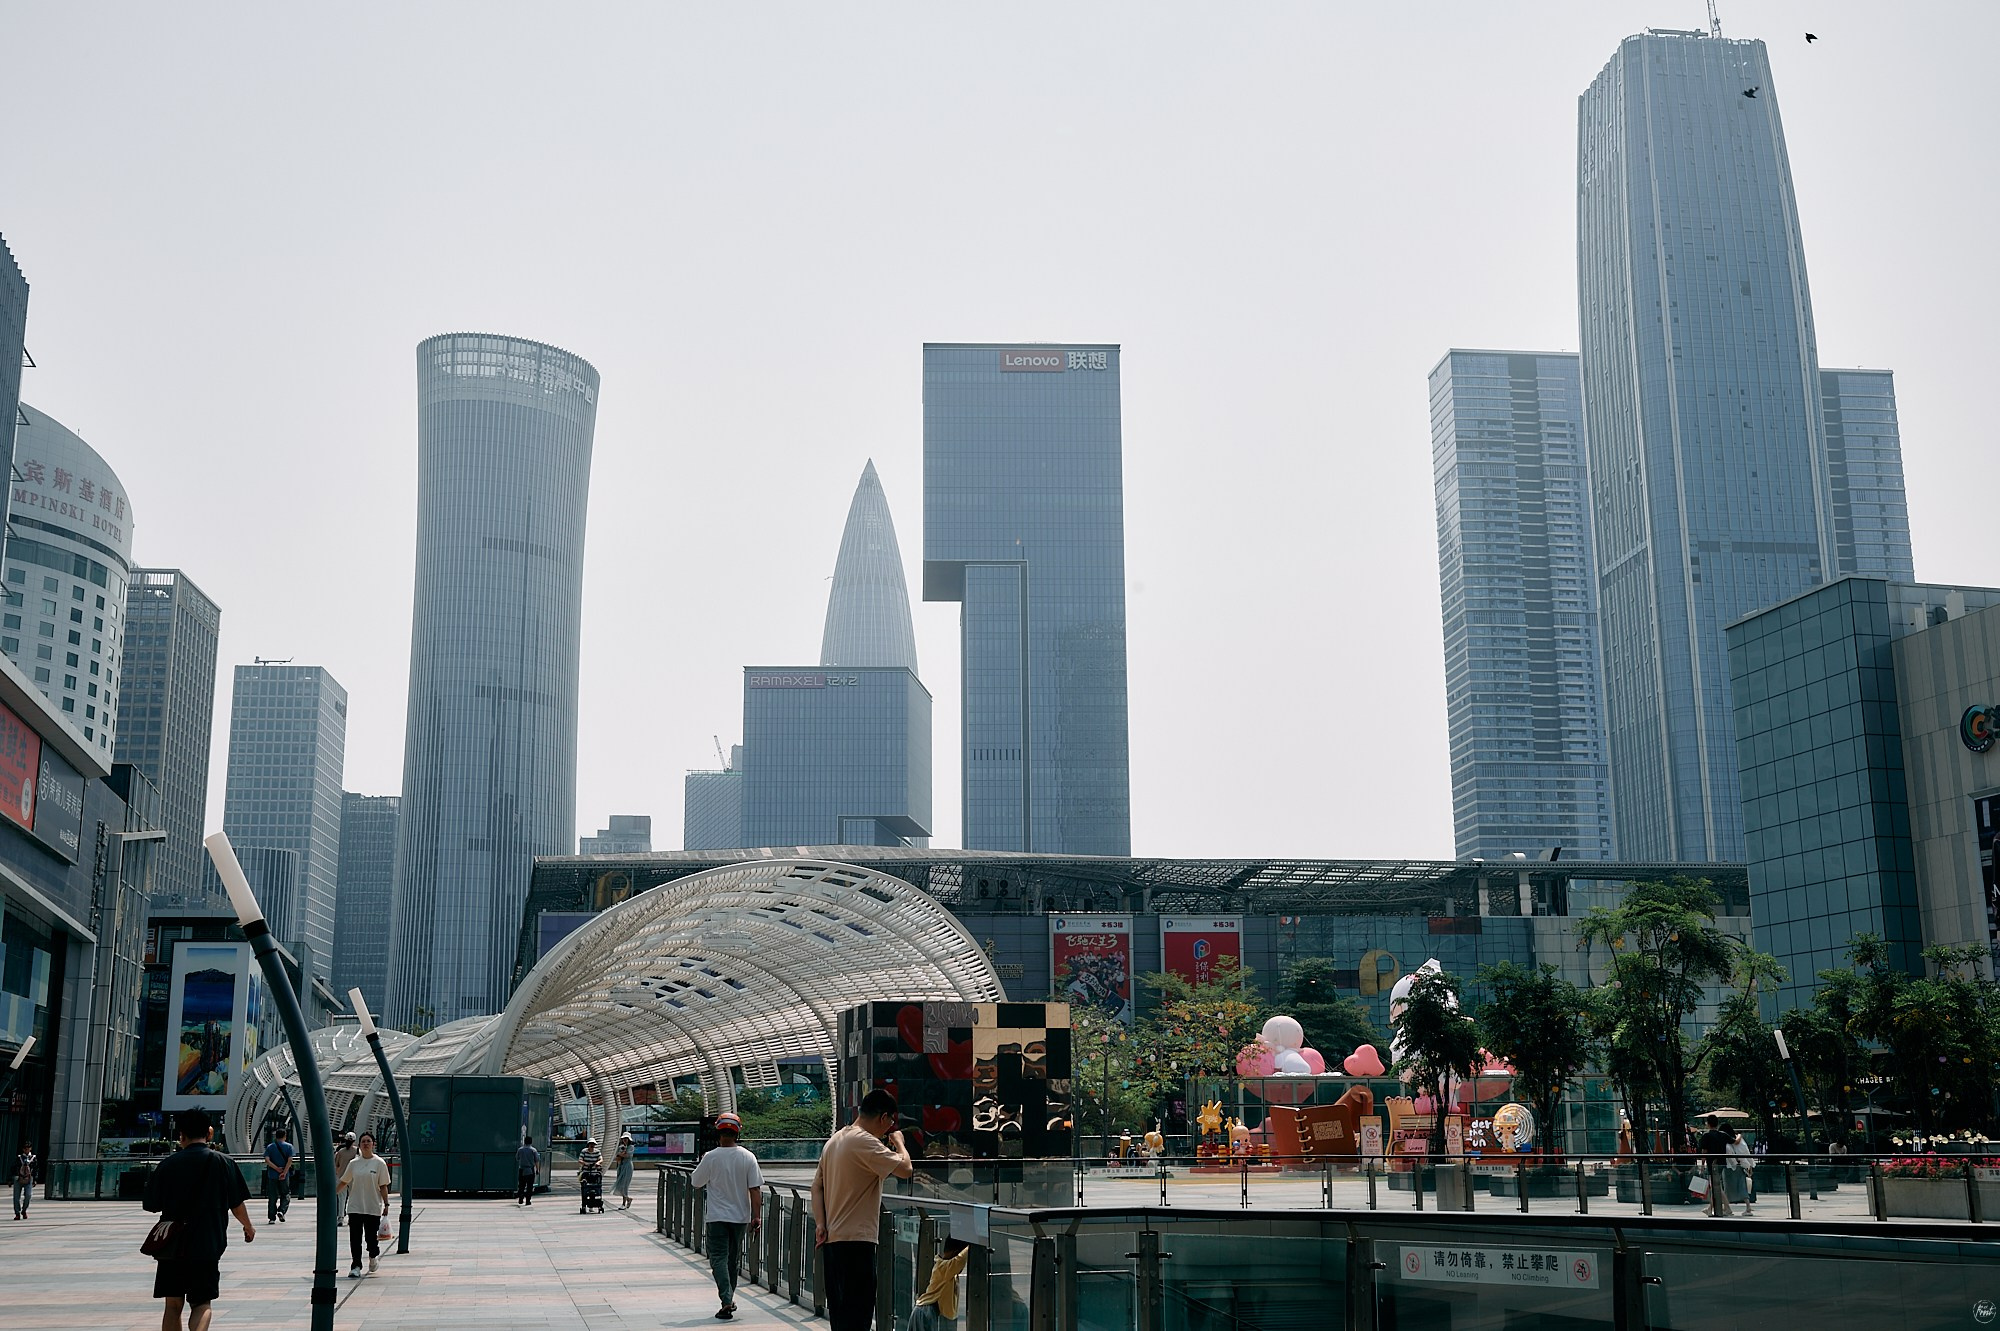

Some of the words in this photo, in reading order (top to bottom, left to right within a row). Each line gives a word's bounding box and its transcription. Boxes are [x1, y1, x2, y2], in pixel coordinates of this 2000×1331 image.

[1005, 354, 1060, 366] Lenovo
[1067, 351, 1108, 371] 联想
[23, 459, 125, 521] 宾斯基酒店
[92, 513, 123, 543] HOTEL
[750, 676, 824, 686] RAMAXEL
[1446, 1270, 1456, 1278] NO
[1457, 1271, 1479, 1281] Leaning
[1511, 1273, 1522, 1281] NO
[1523, 1274, 1549, 1284] Climbing
